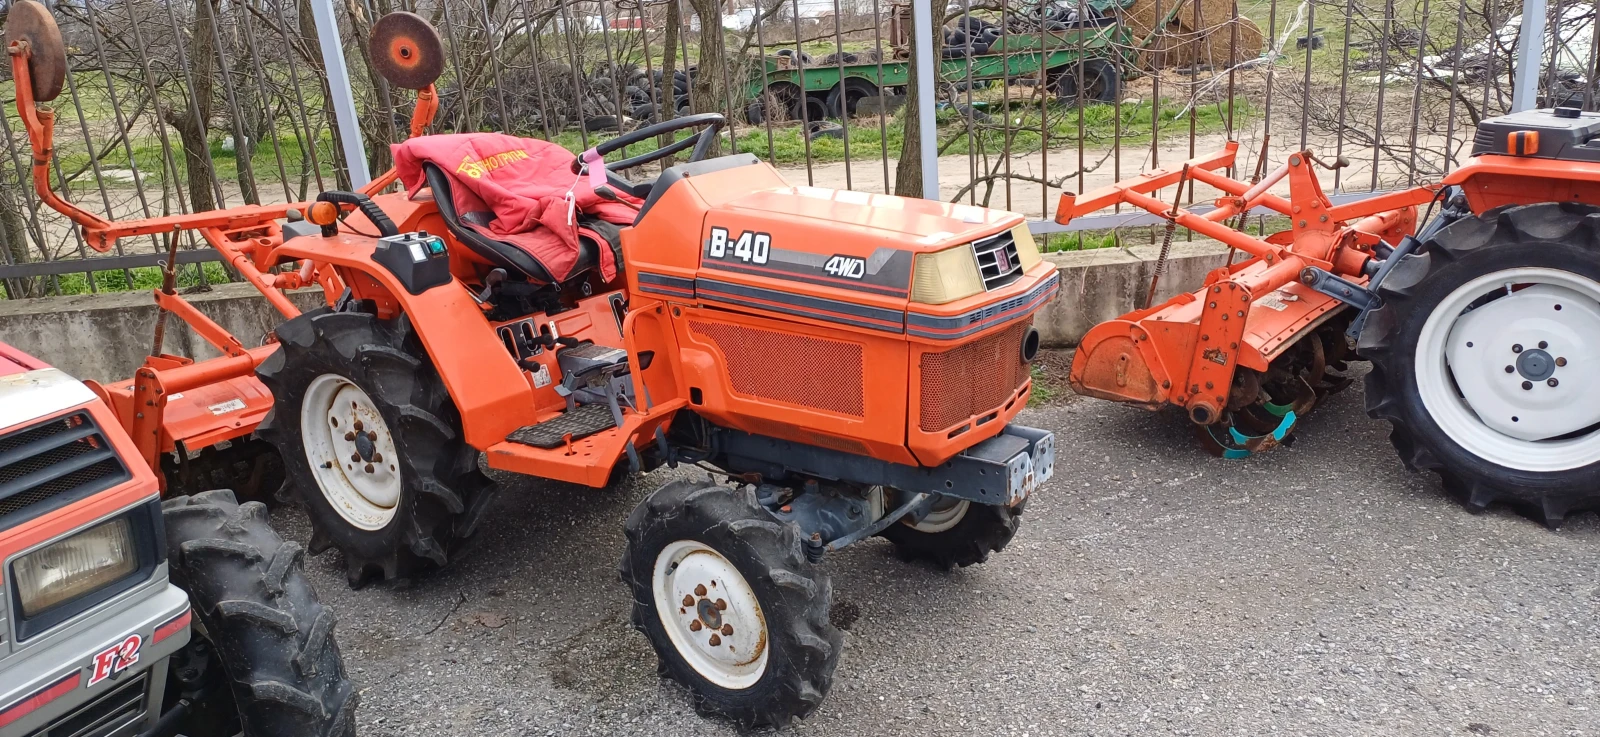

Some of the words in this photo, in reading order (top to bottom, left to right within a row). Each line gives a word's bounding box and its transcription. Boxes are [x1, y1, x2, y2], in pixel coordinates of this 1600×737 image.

[709, 227, 771, 264] B-40
[824, 256, 866, 279] 4WD
[87, 634, 142, 688] F2
